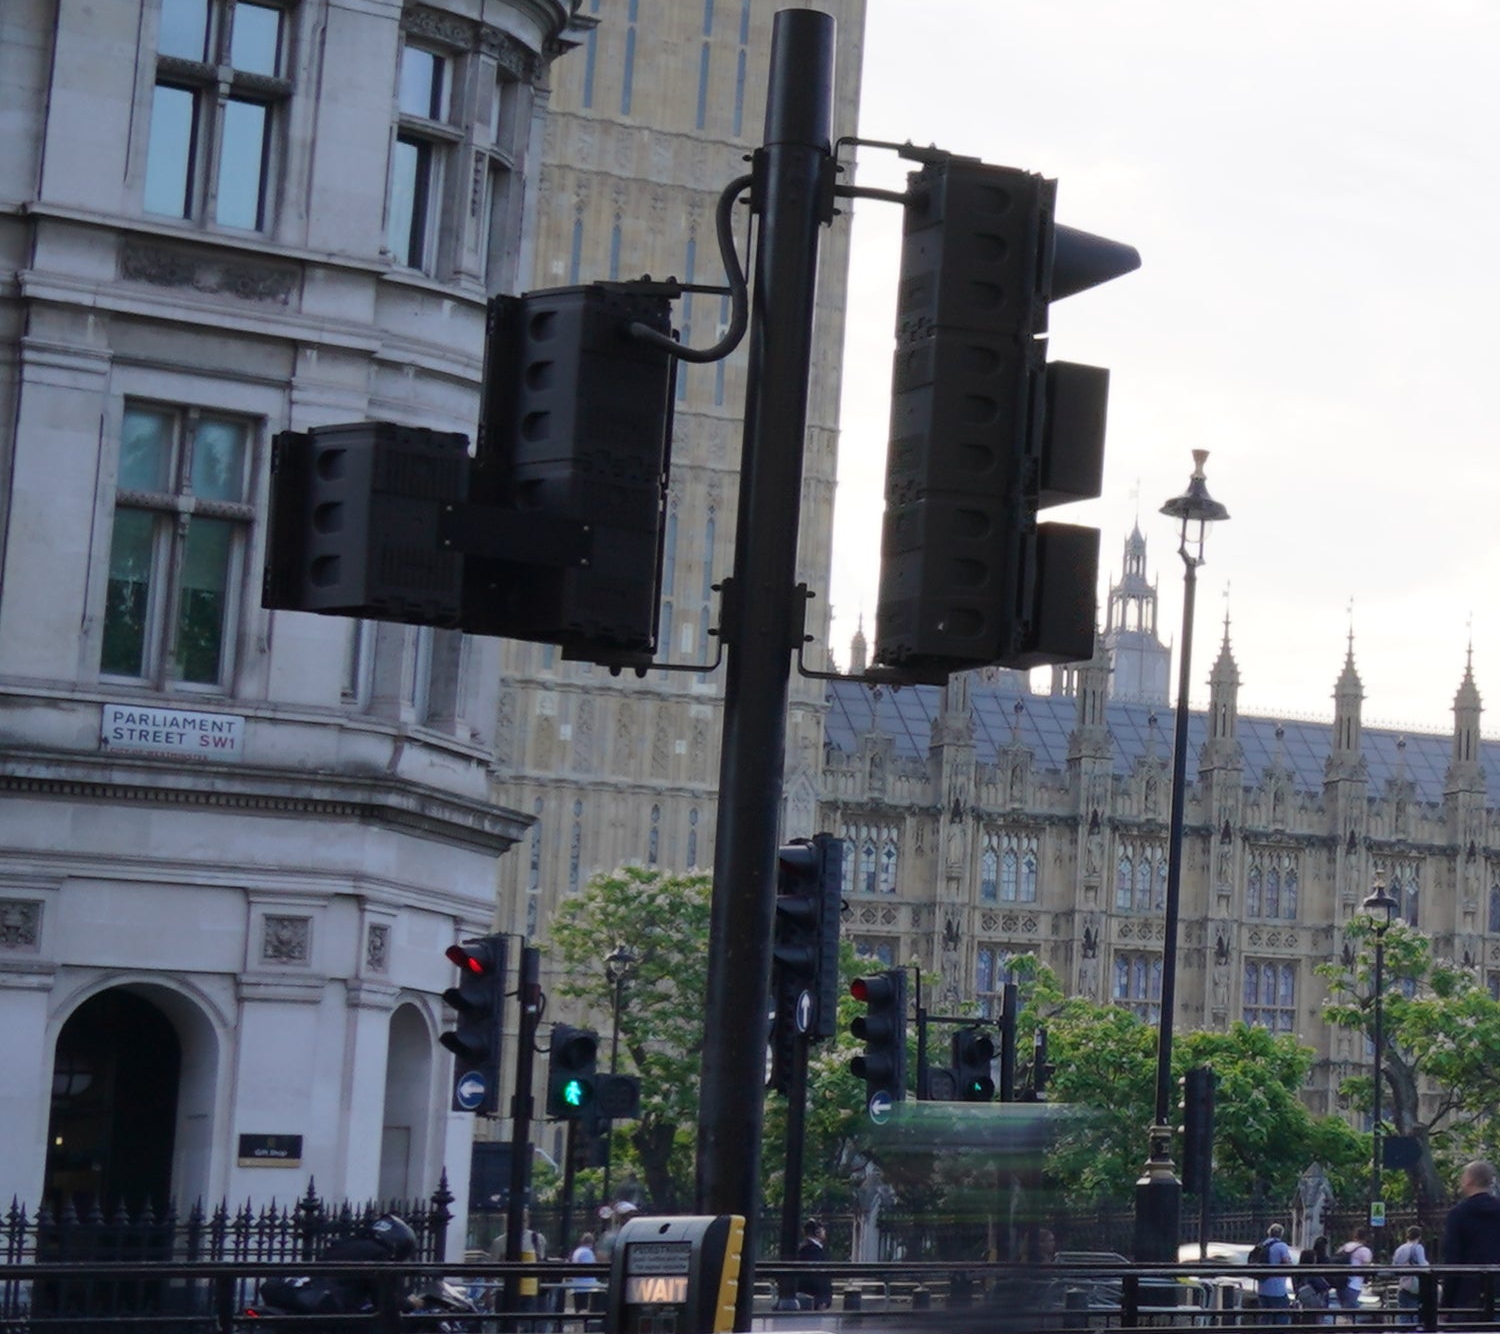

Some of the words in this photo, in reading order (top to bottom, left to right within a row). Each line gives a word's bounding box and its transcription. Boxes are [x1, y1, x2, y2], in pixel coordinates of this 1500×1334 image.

[113, 710, 236, 734] PARLIAMENT
[112, 726, 186, 745] STREET
[199, 734, 235, 750] SW1
[630, 1276, 689, 1303] WAIT
